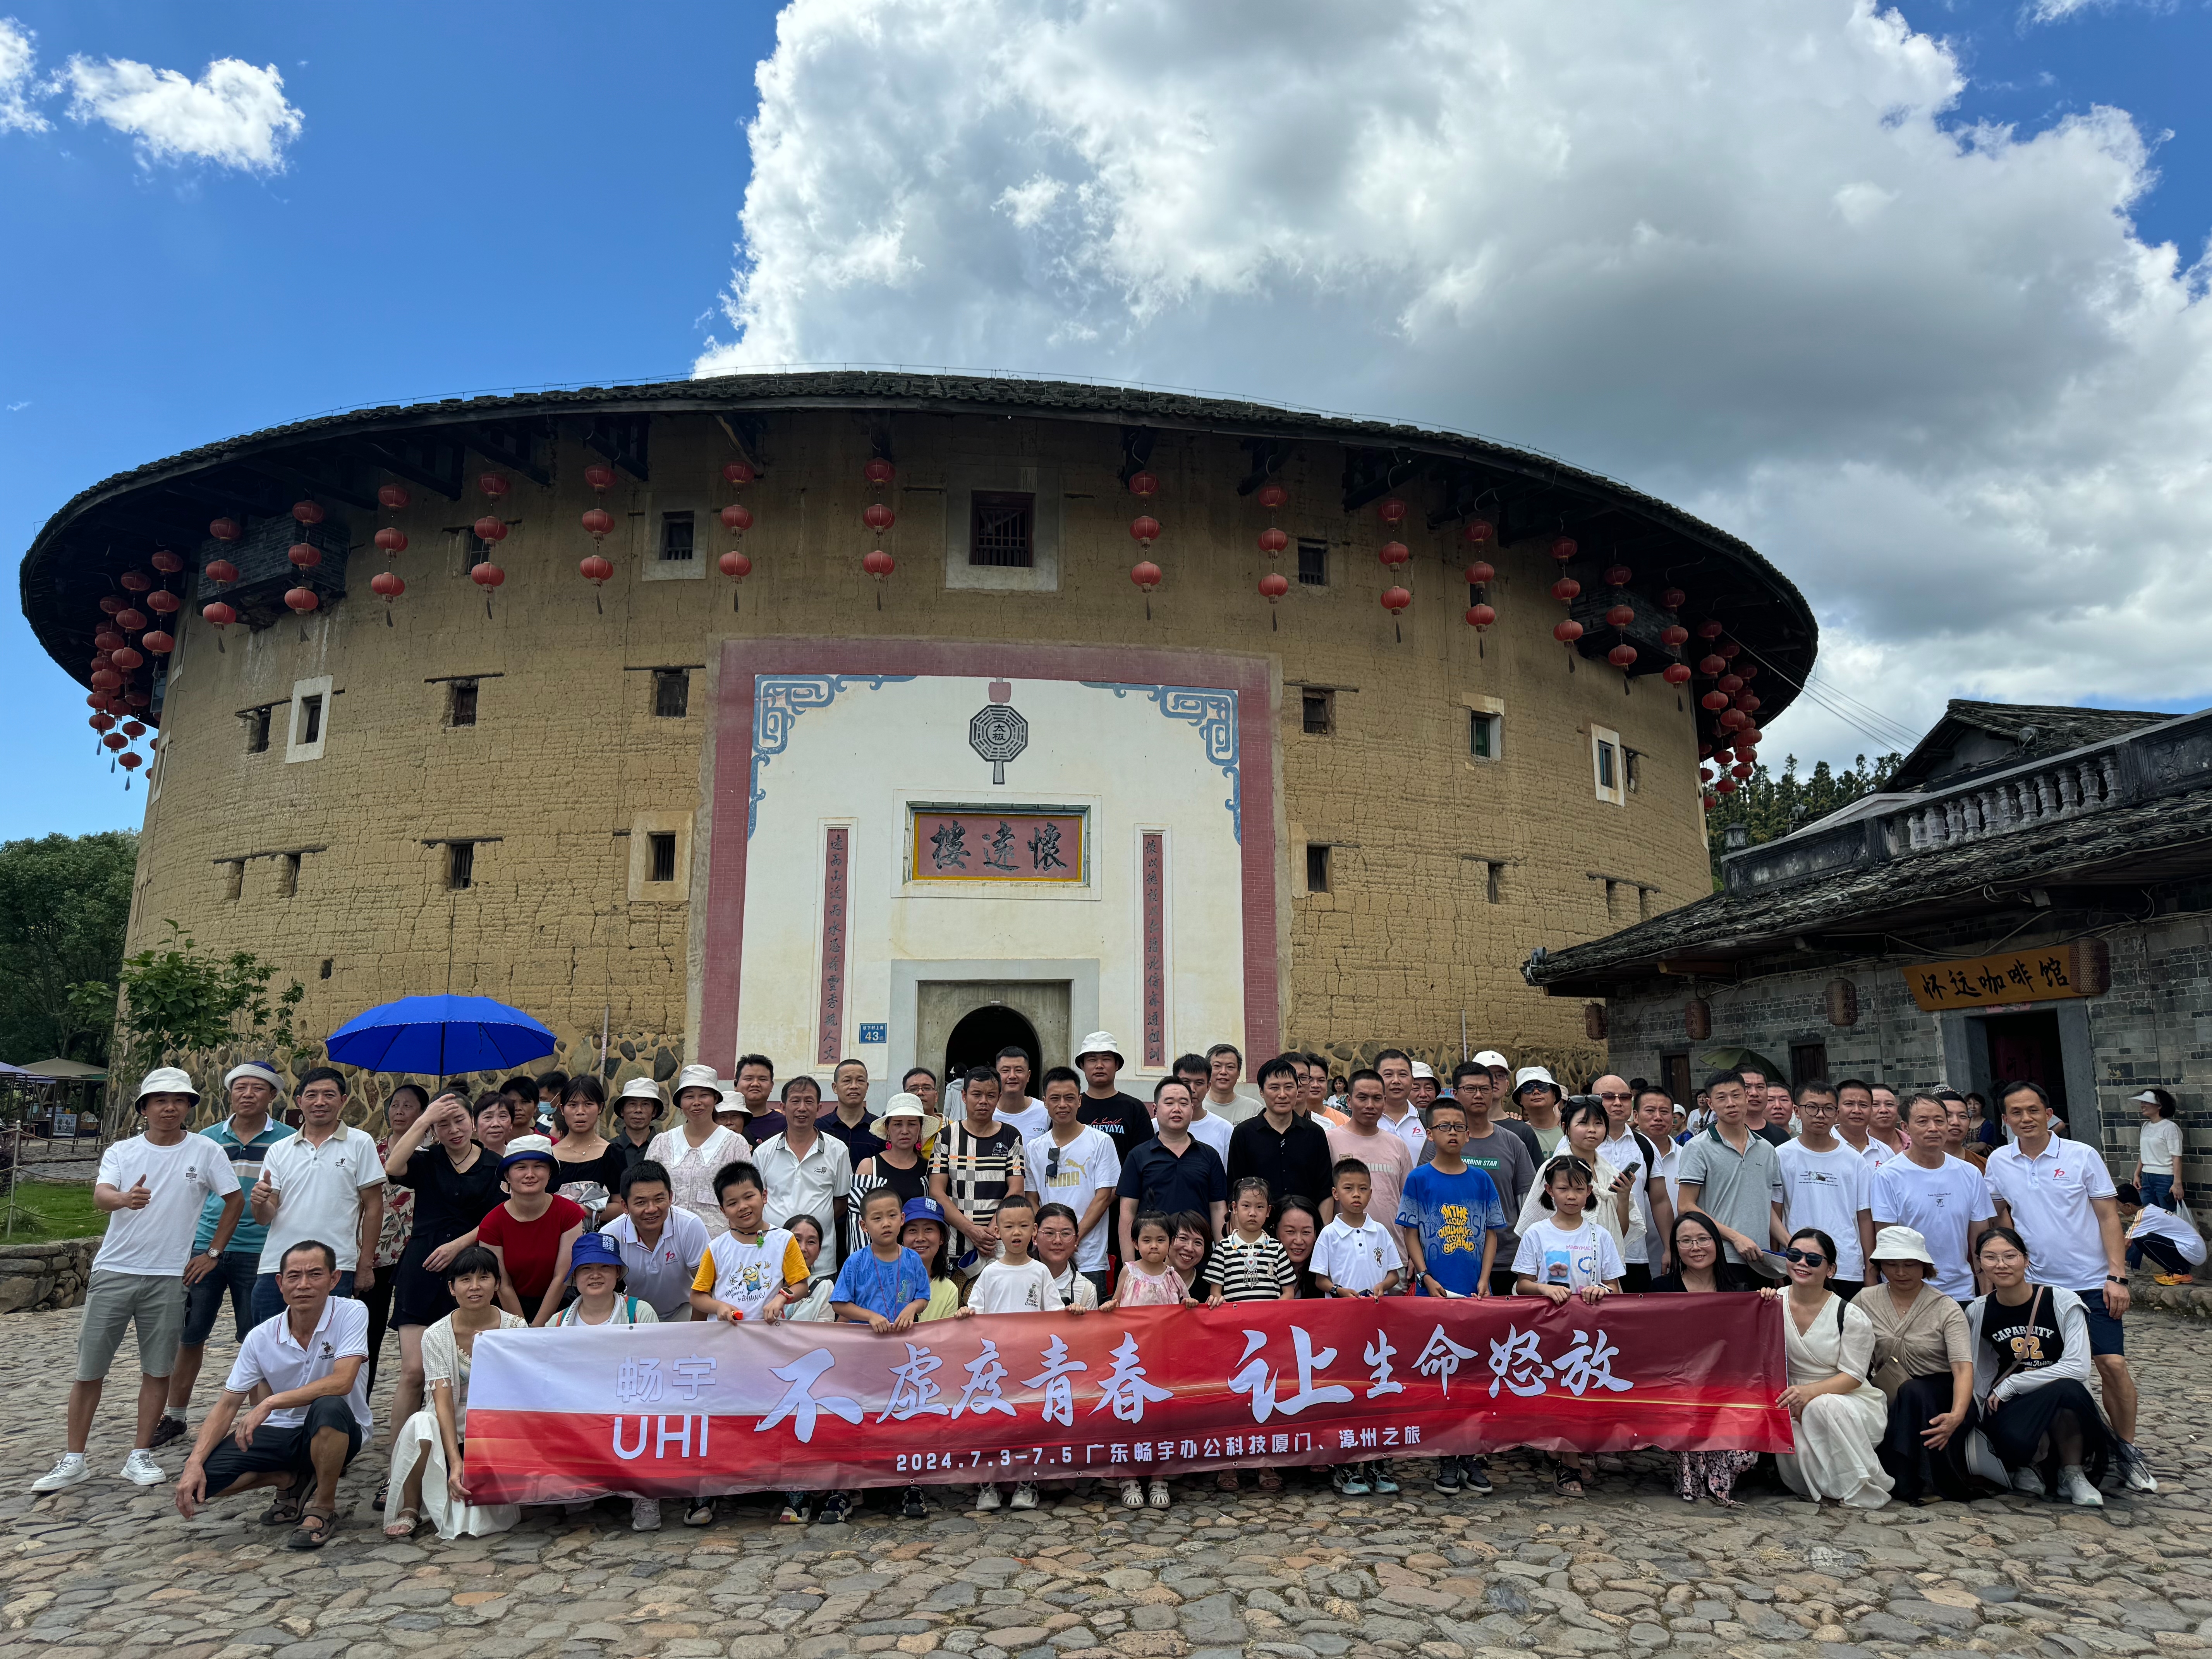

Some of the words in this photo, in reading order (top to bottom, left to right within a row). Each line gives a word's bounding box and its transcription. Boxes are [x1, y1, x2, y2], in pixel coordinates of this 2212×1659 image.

[1920, 957, 2070, 1000] 怀远咖啡馆
[865, 1031, 879, 1041] 43
[2011, 1336, 2045, 1359] 92
[616, 1353, 717, 1403] 畅宇
[1228, 1322, 1635, 1424] 让生命怒放
[613, 1414, 709, 1460] UHI
[1086, 1425, 1421, 1463] 广东畅宇办公科技厦门、漳州之旅
